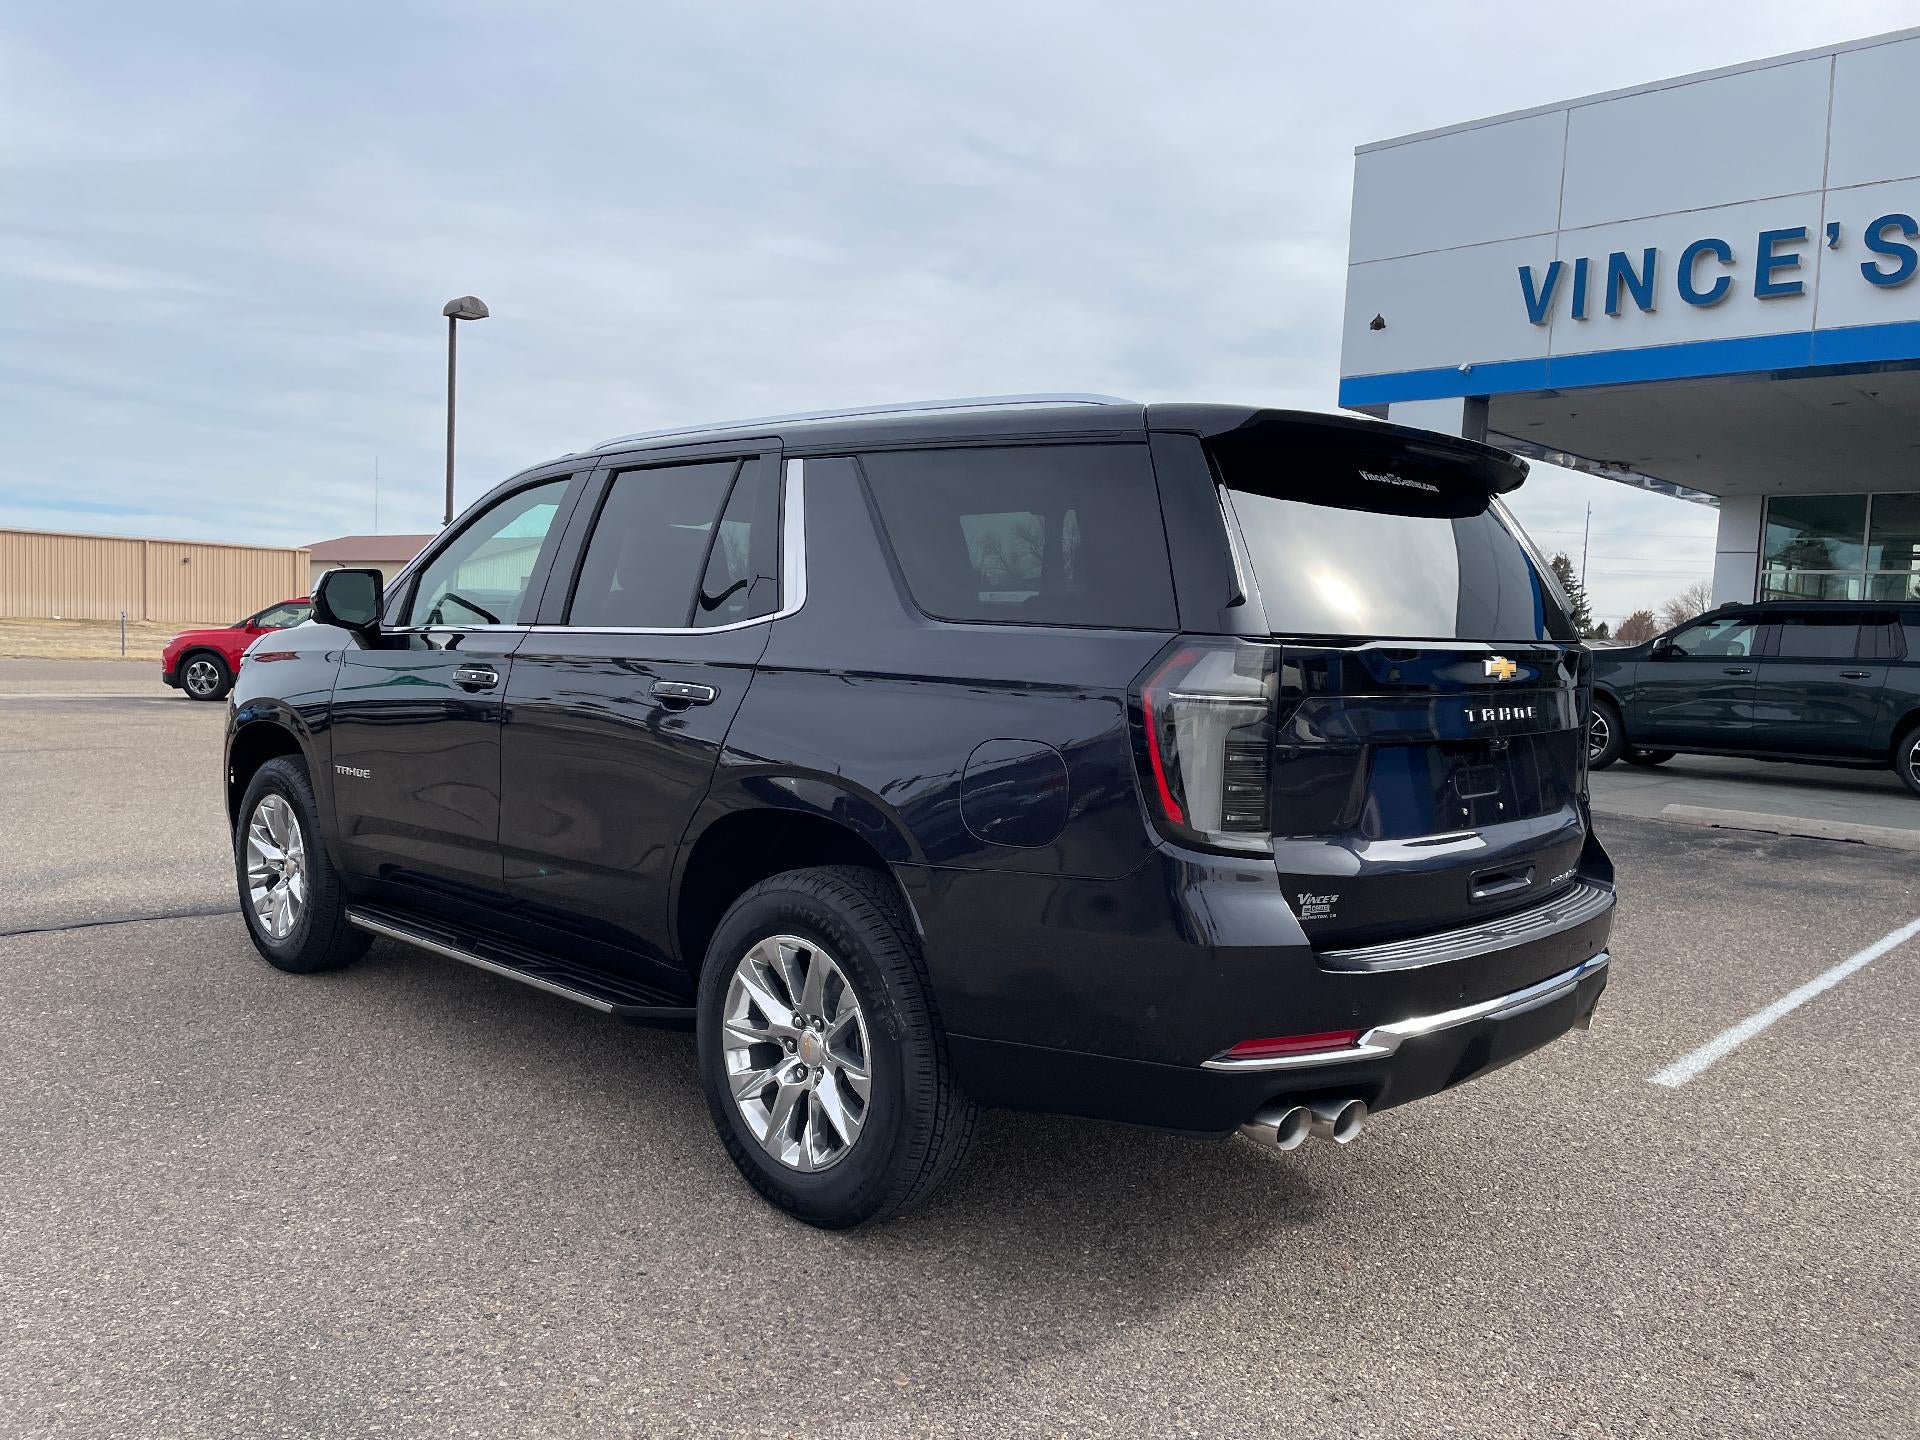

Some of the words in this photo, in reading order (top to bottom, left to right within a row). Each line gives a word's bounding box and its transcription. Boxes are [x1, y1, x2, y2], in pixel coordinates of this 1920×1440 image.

[1518, 213, 1920, 326] VINCE'S
[1464, 706, 1537, 722] TAHOE
[334, 765, 371, 779] TAHOE
